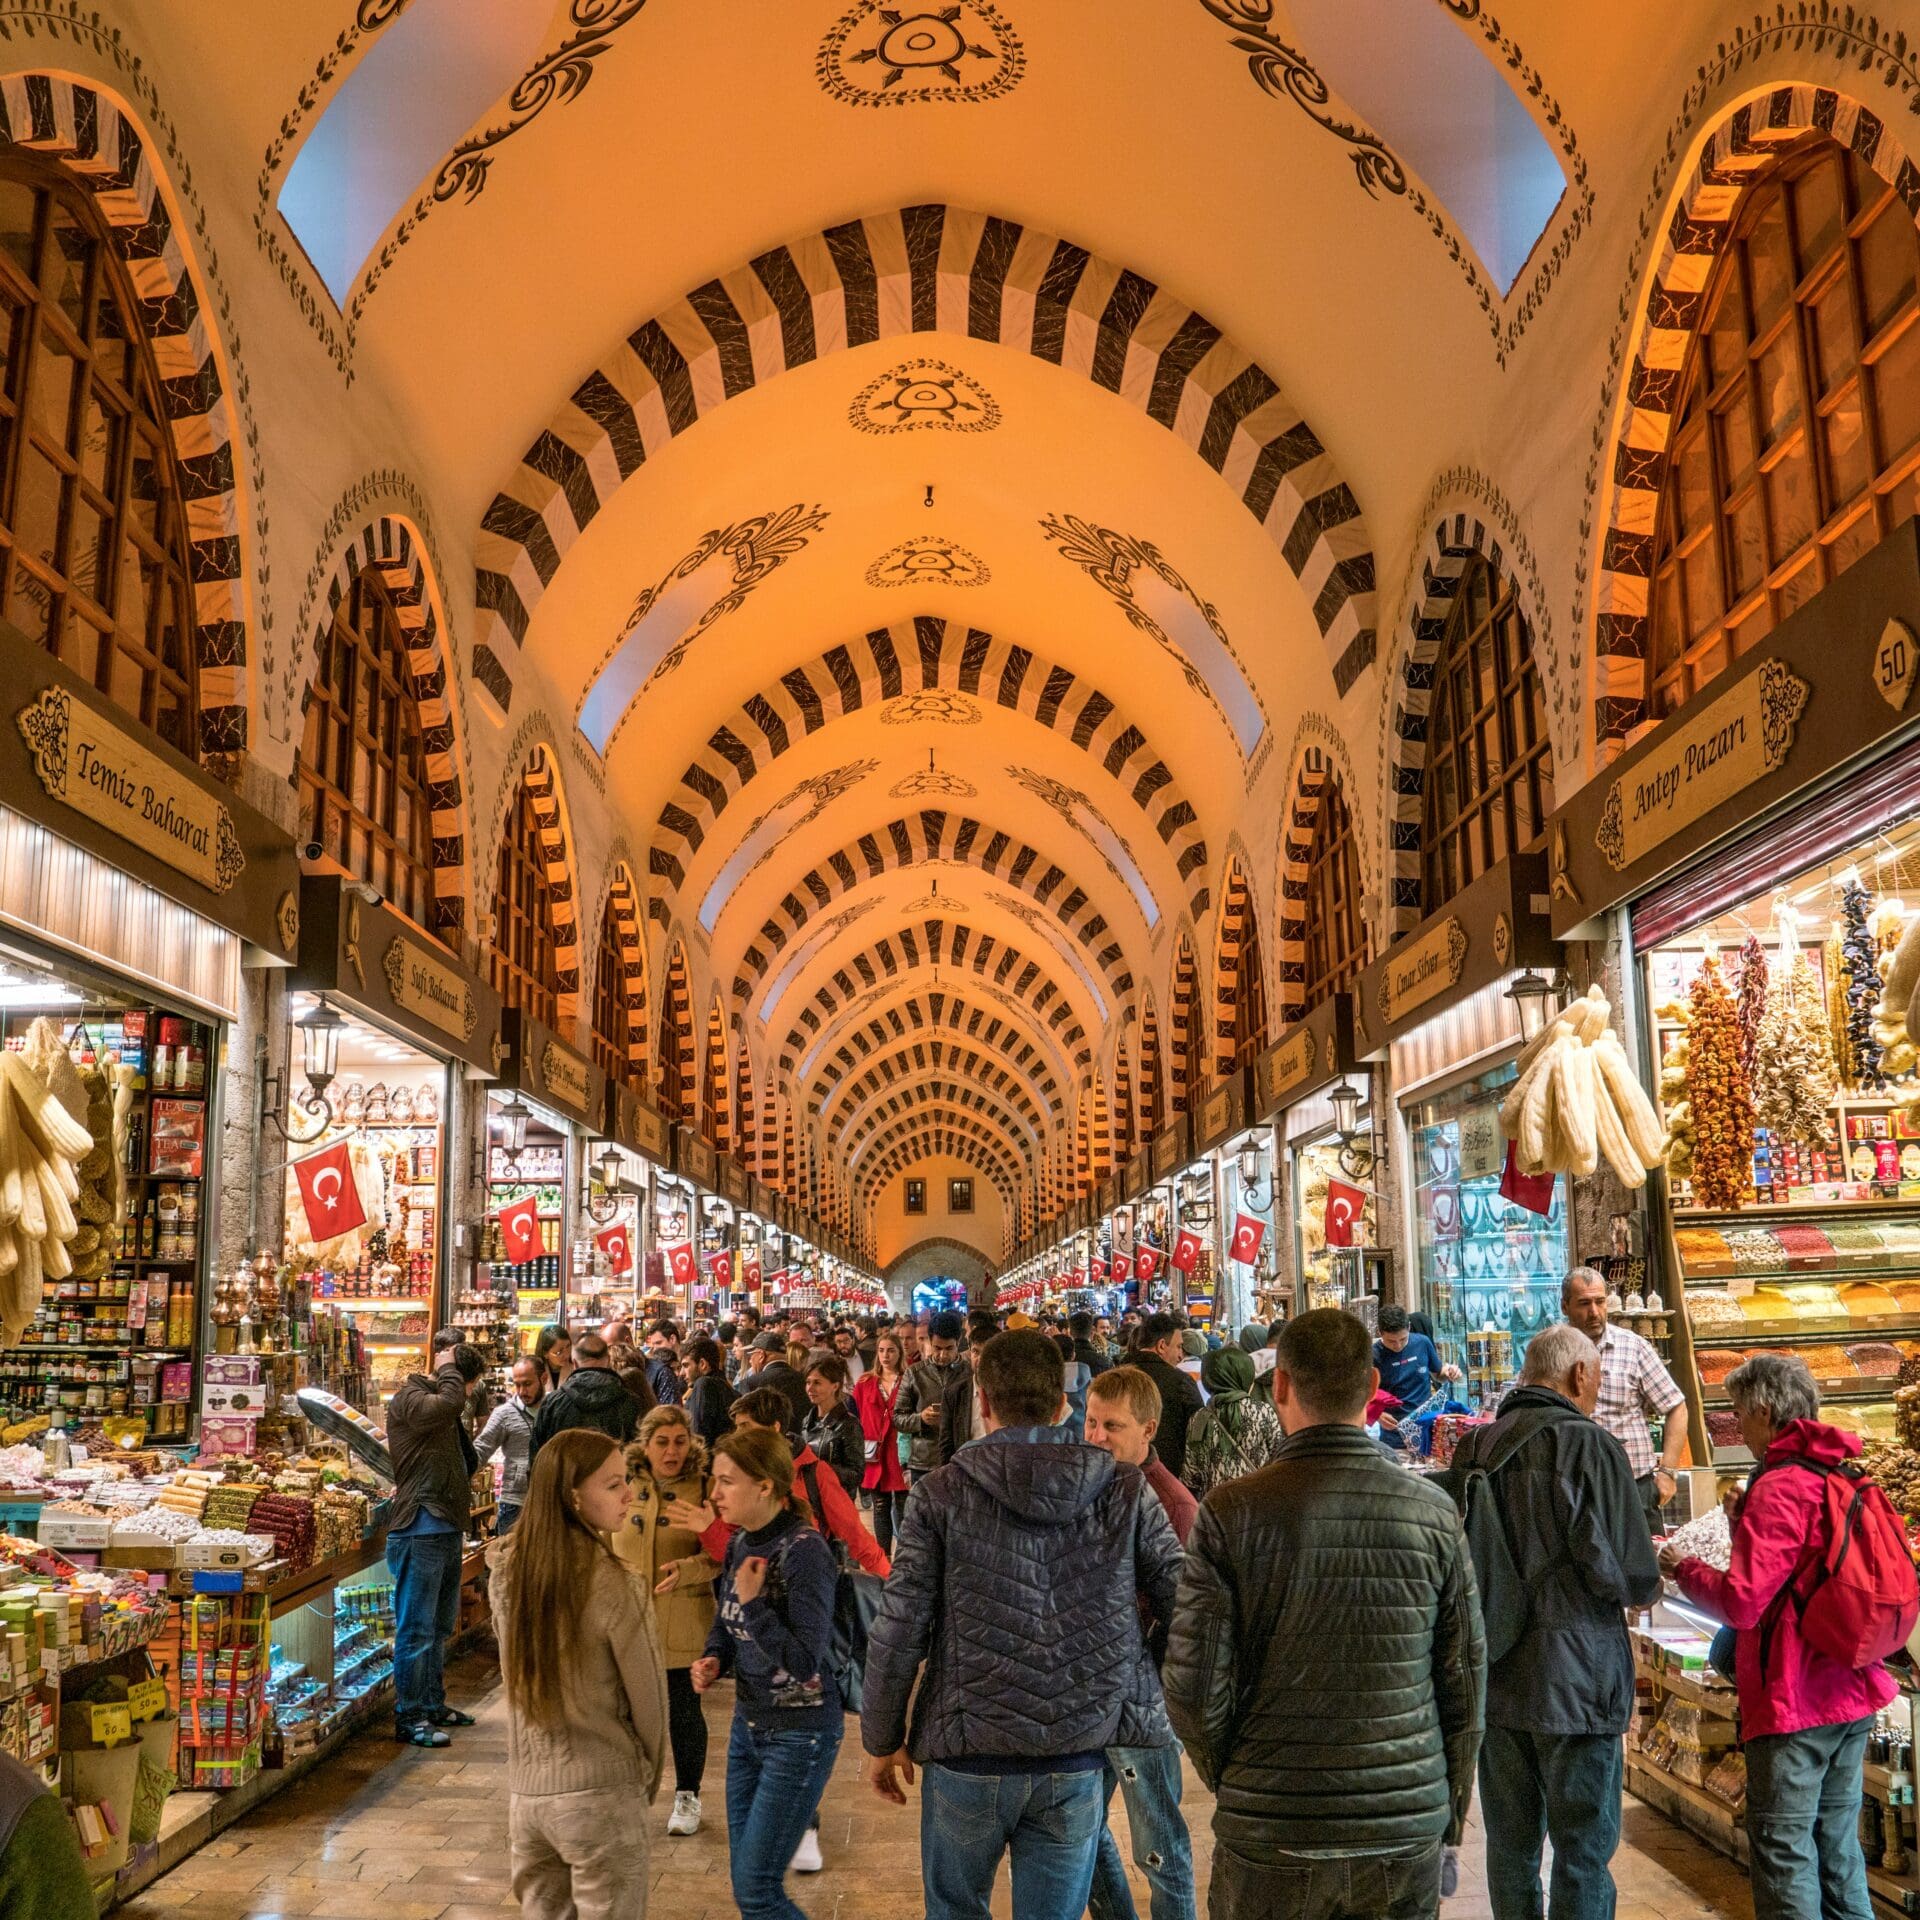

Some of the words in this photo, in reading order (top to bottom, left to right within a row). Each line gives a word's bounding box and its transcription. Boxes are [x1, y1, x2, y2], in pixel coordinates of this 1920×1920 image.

[1881, 640, 1905, 687] 50
[1633, 762, 1680, 822] Antep
[1684, 714, 1747, 783] Pazarı
[76, 743, 135, 809] Temiz
[141, 785, 210, 856] Baharat
[284, 906, 296, 934] 43
[1495, 926, 1505, 952] 52
[1417, 950, 1439, 983] Silver
[411, 963, 427, 1000] Sufi
[428, 975, 459, 1014] Baharat
[159, 1100, 182, 1111] TEA
[155, 1138, 179, 1149] TEA
[139, 1699, 151, 1711] 50
